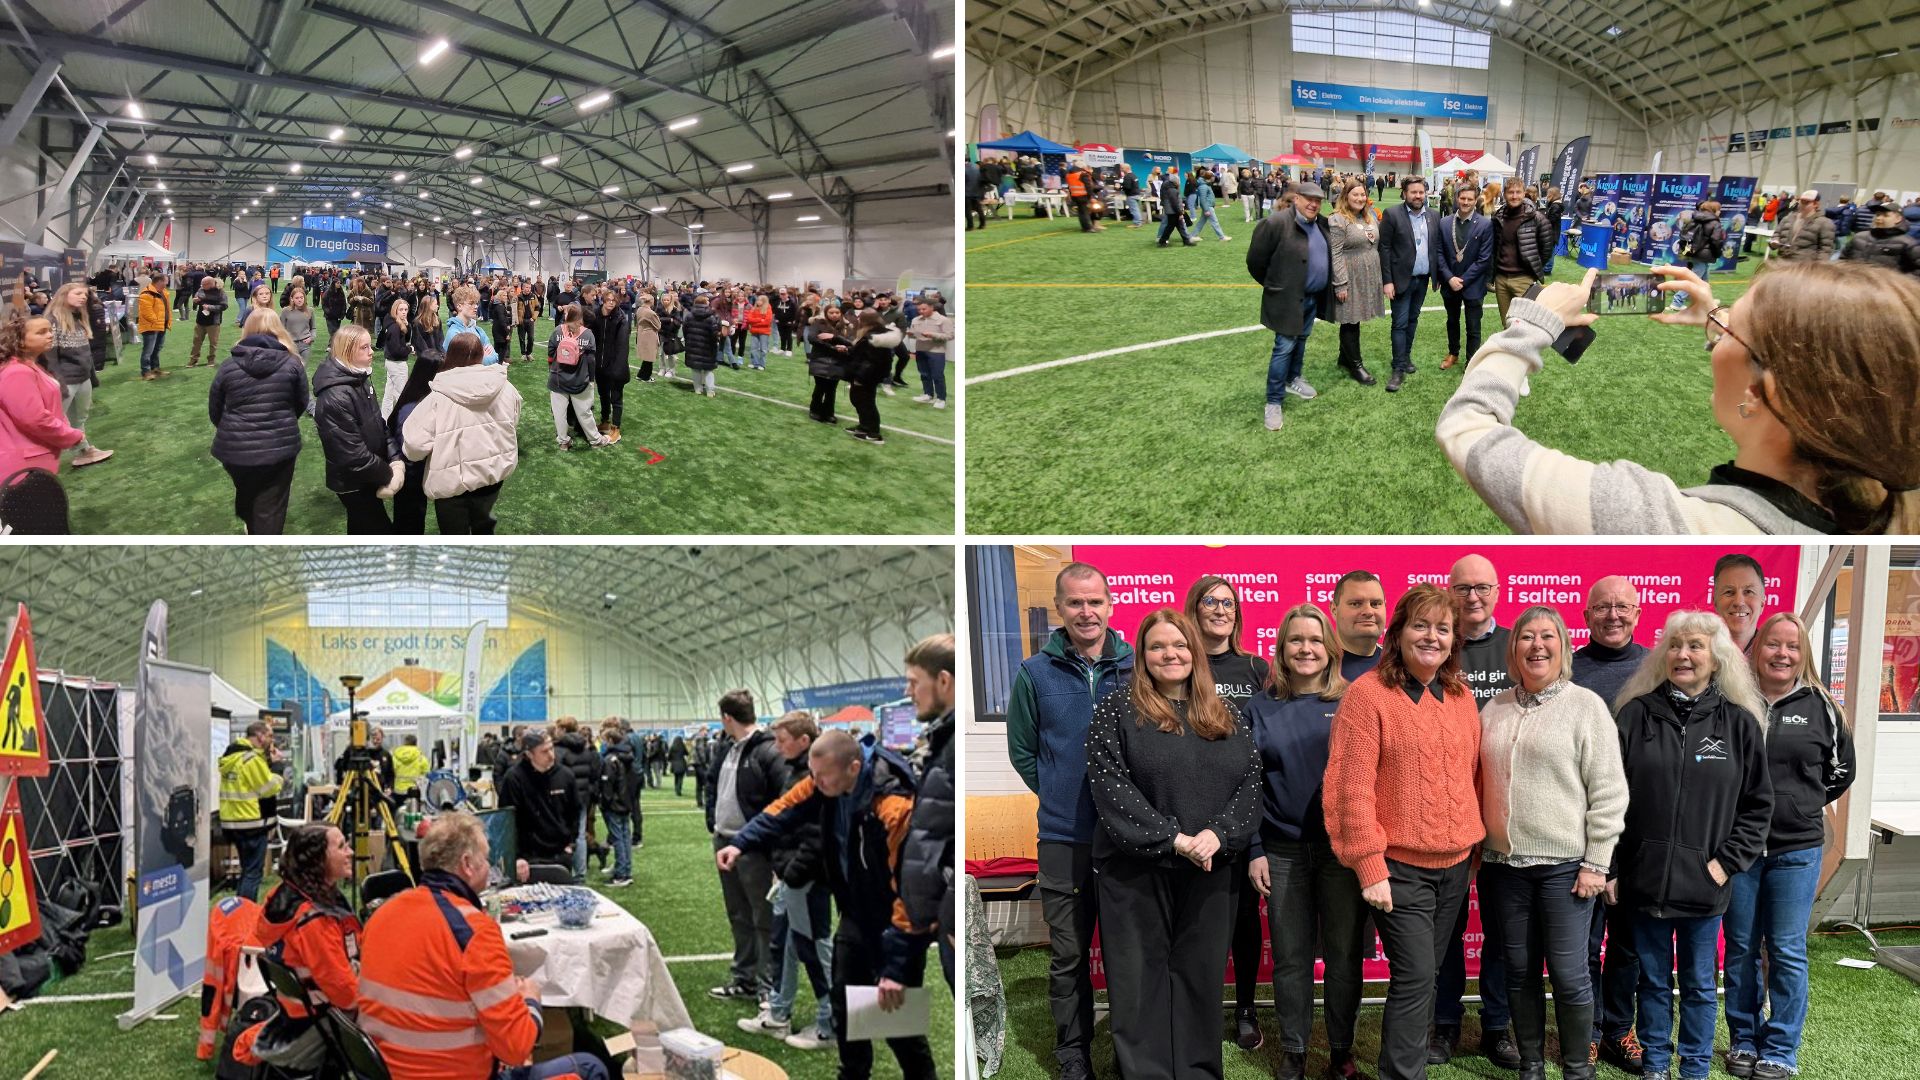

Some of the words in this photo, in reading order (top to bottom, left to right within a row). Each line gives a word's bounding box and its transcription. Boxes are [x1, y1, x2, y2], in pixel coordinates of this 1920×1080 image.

[1297, 86, 1317, 99] ise
[1321, 92, 1342, 100] Elektro
[1359, 95, 1371, 103] Din
[1373, 96, 1393, 105] lokale
[1394, 98, 1426, 108] elektriker
[1443, 98, 1460, 110] ise
[305, 236, 380, 253] Dragefossen
[1107, 573, 1174, 586] ammen
[1508, 574, 1582, 586] sammen
[1237, 587, 1279, 603] lten
[1508, 588, 1513, 604] i
[1518, 588, 1581, 604] salten
[321, 633, 357, 650] Laks
[362, 637, 379, 650] er
[384, 633, 419, 655] godt
[1488, 669, 1507, 683] gir
[1215, 683, 1252, 695] RPULS
[152, 874, 177, 890] mesta
